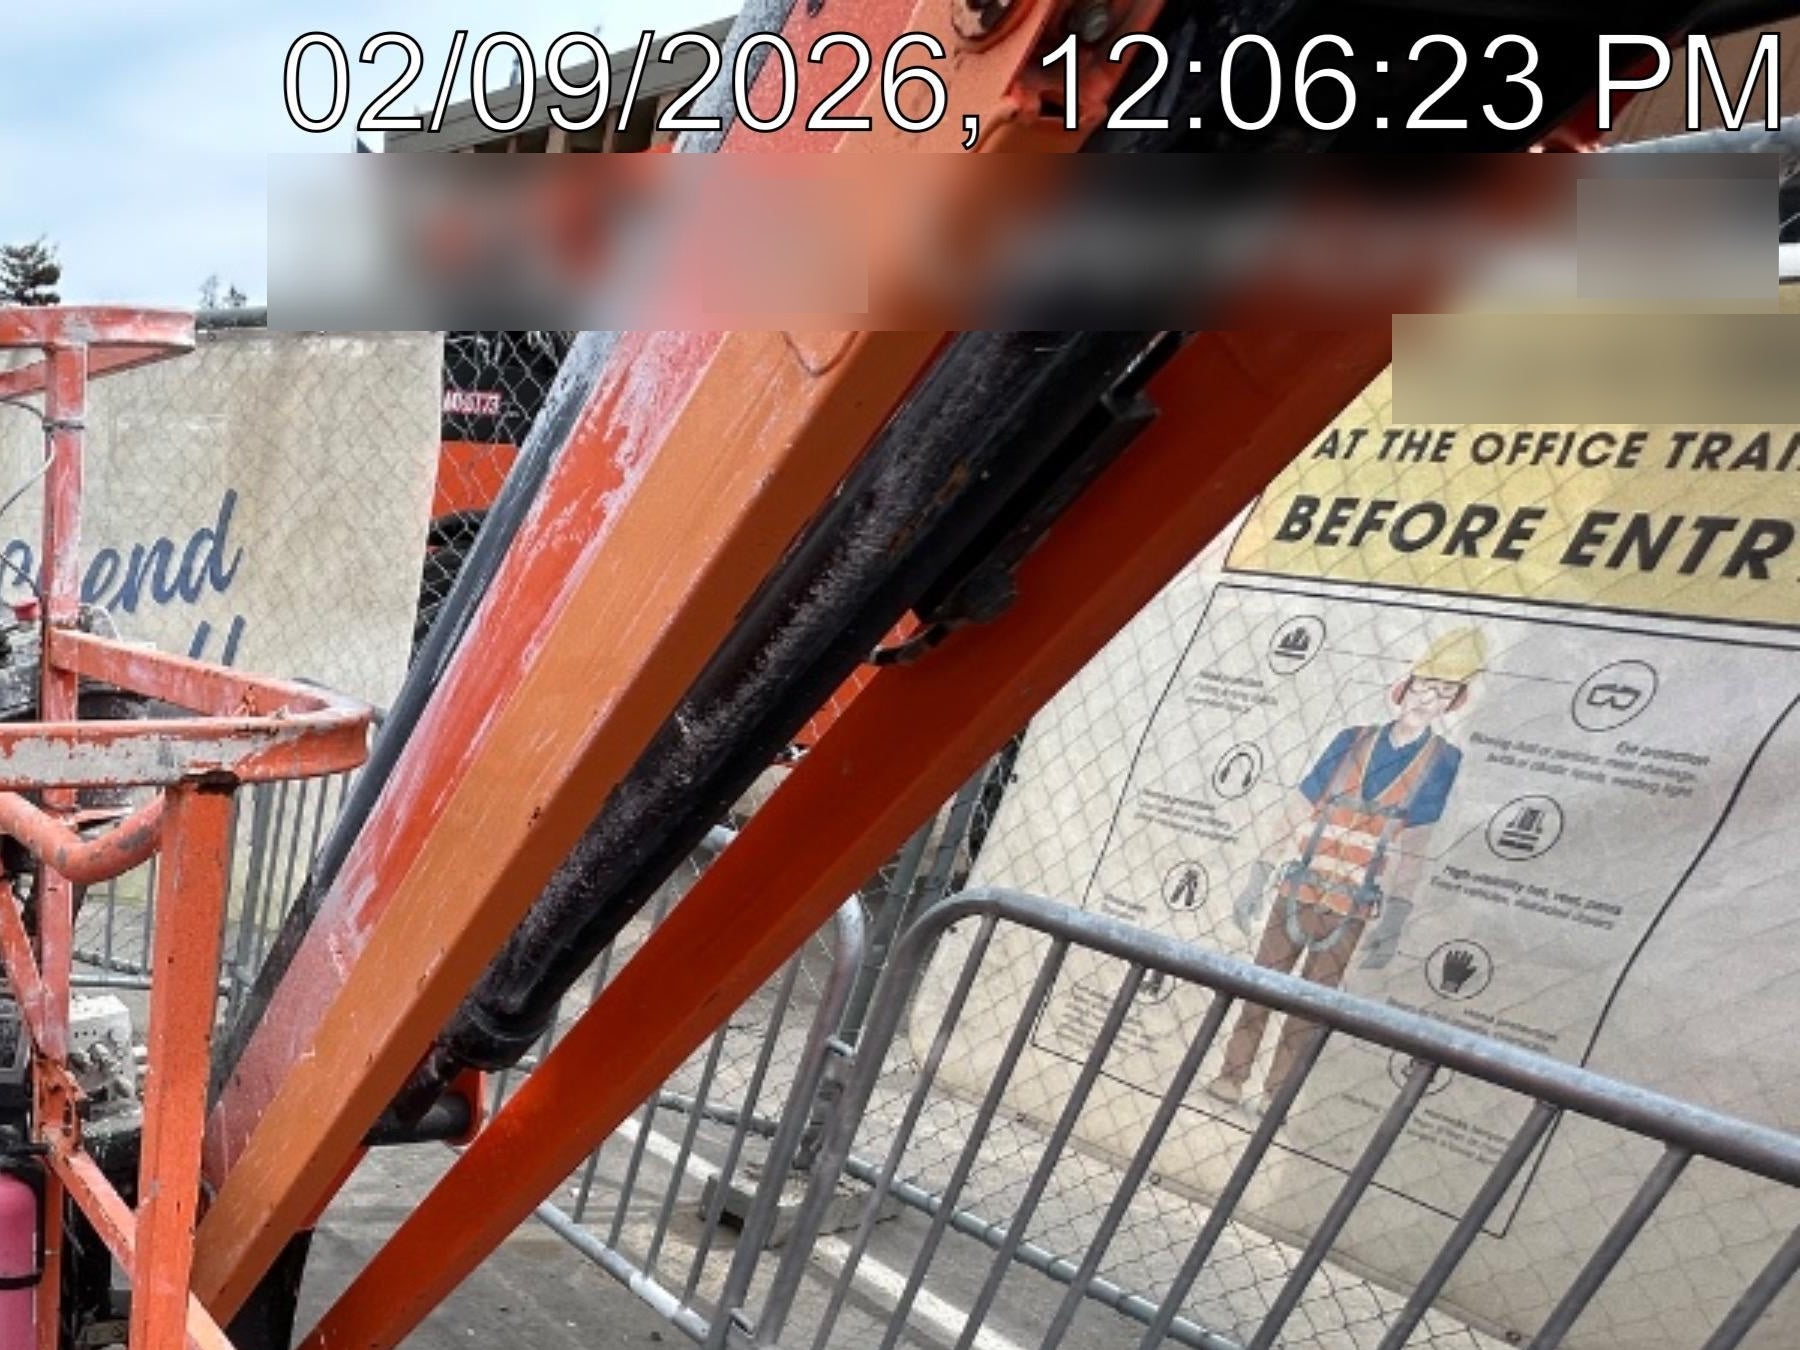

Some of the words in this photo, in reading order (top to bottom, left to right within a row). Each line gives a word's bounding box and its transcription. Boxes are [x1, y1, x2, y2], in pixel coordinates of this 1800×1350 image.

[1311, 428, 1368, 461] AT
[1376, 428, 1456, 464] THE
[1470, 430, 1648, 470] OFFICE
[1664, 430, 1800, 472] TRAI
[1274, 494, 1546, 561] BEFORE
[1560, 509, 1800, 582] ENTR
